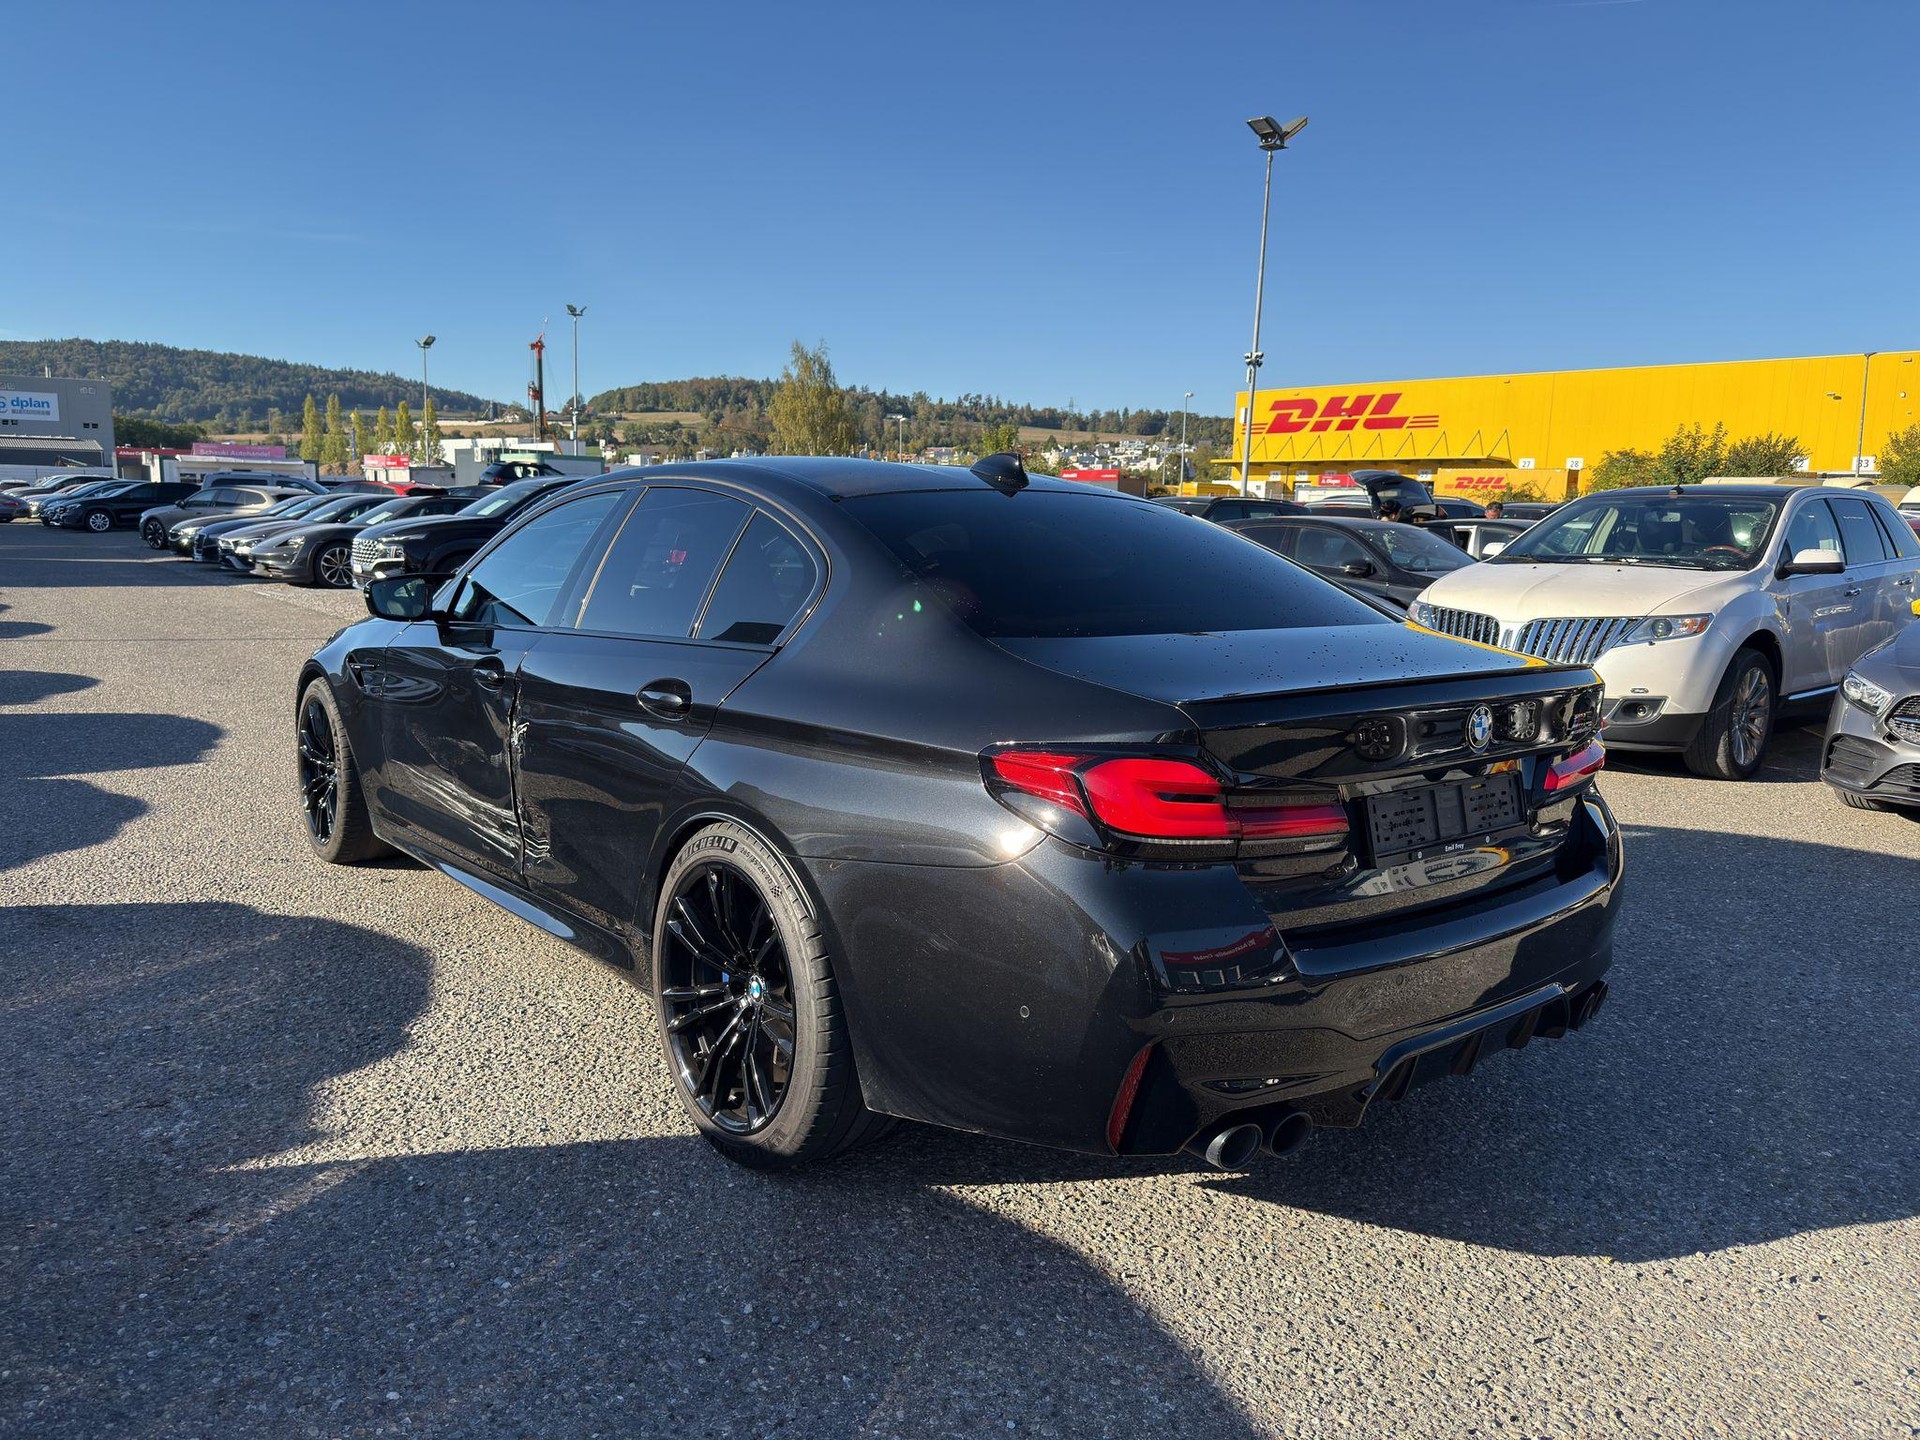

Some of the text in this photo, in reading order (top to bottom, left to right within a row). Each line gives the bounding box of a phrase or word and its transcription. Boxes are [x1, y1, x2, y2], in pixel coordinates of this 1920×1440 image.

[1265, 393, 1409, 434] DHL
[1522, 460, 1531, 468] 27
[1569, 460, 1579, 468] 28
[1455, 476, 1507, 489] DHL
[682, 836, 735, 861] MICHELIN
